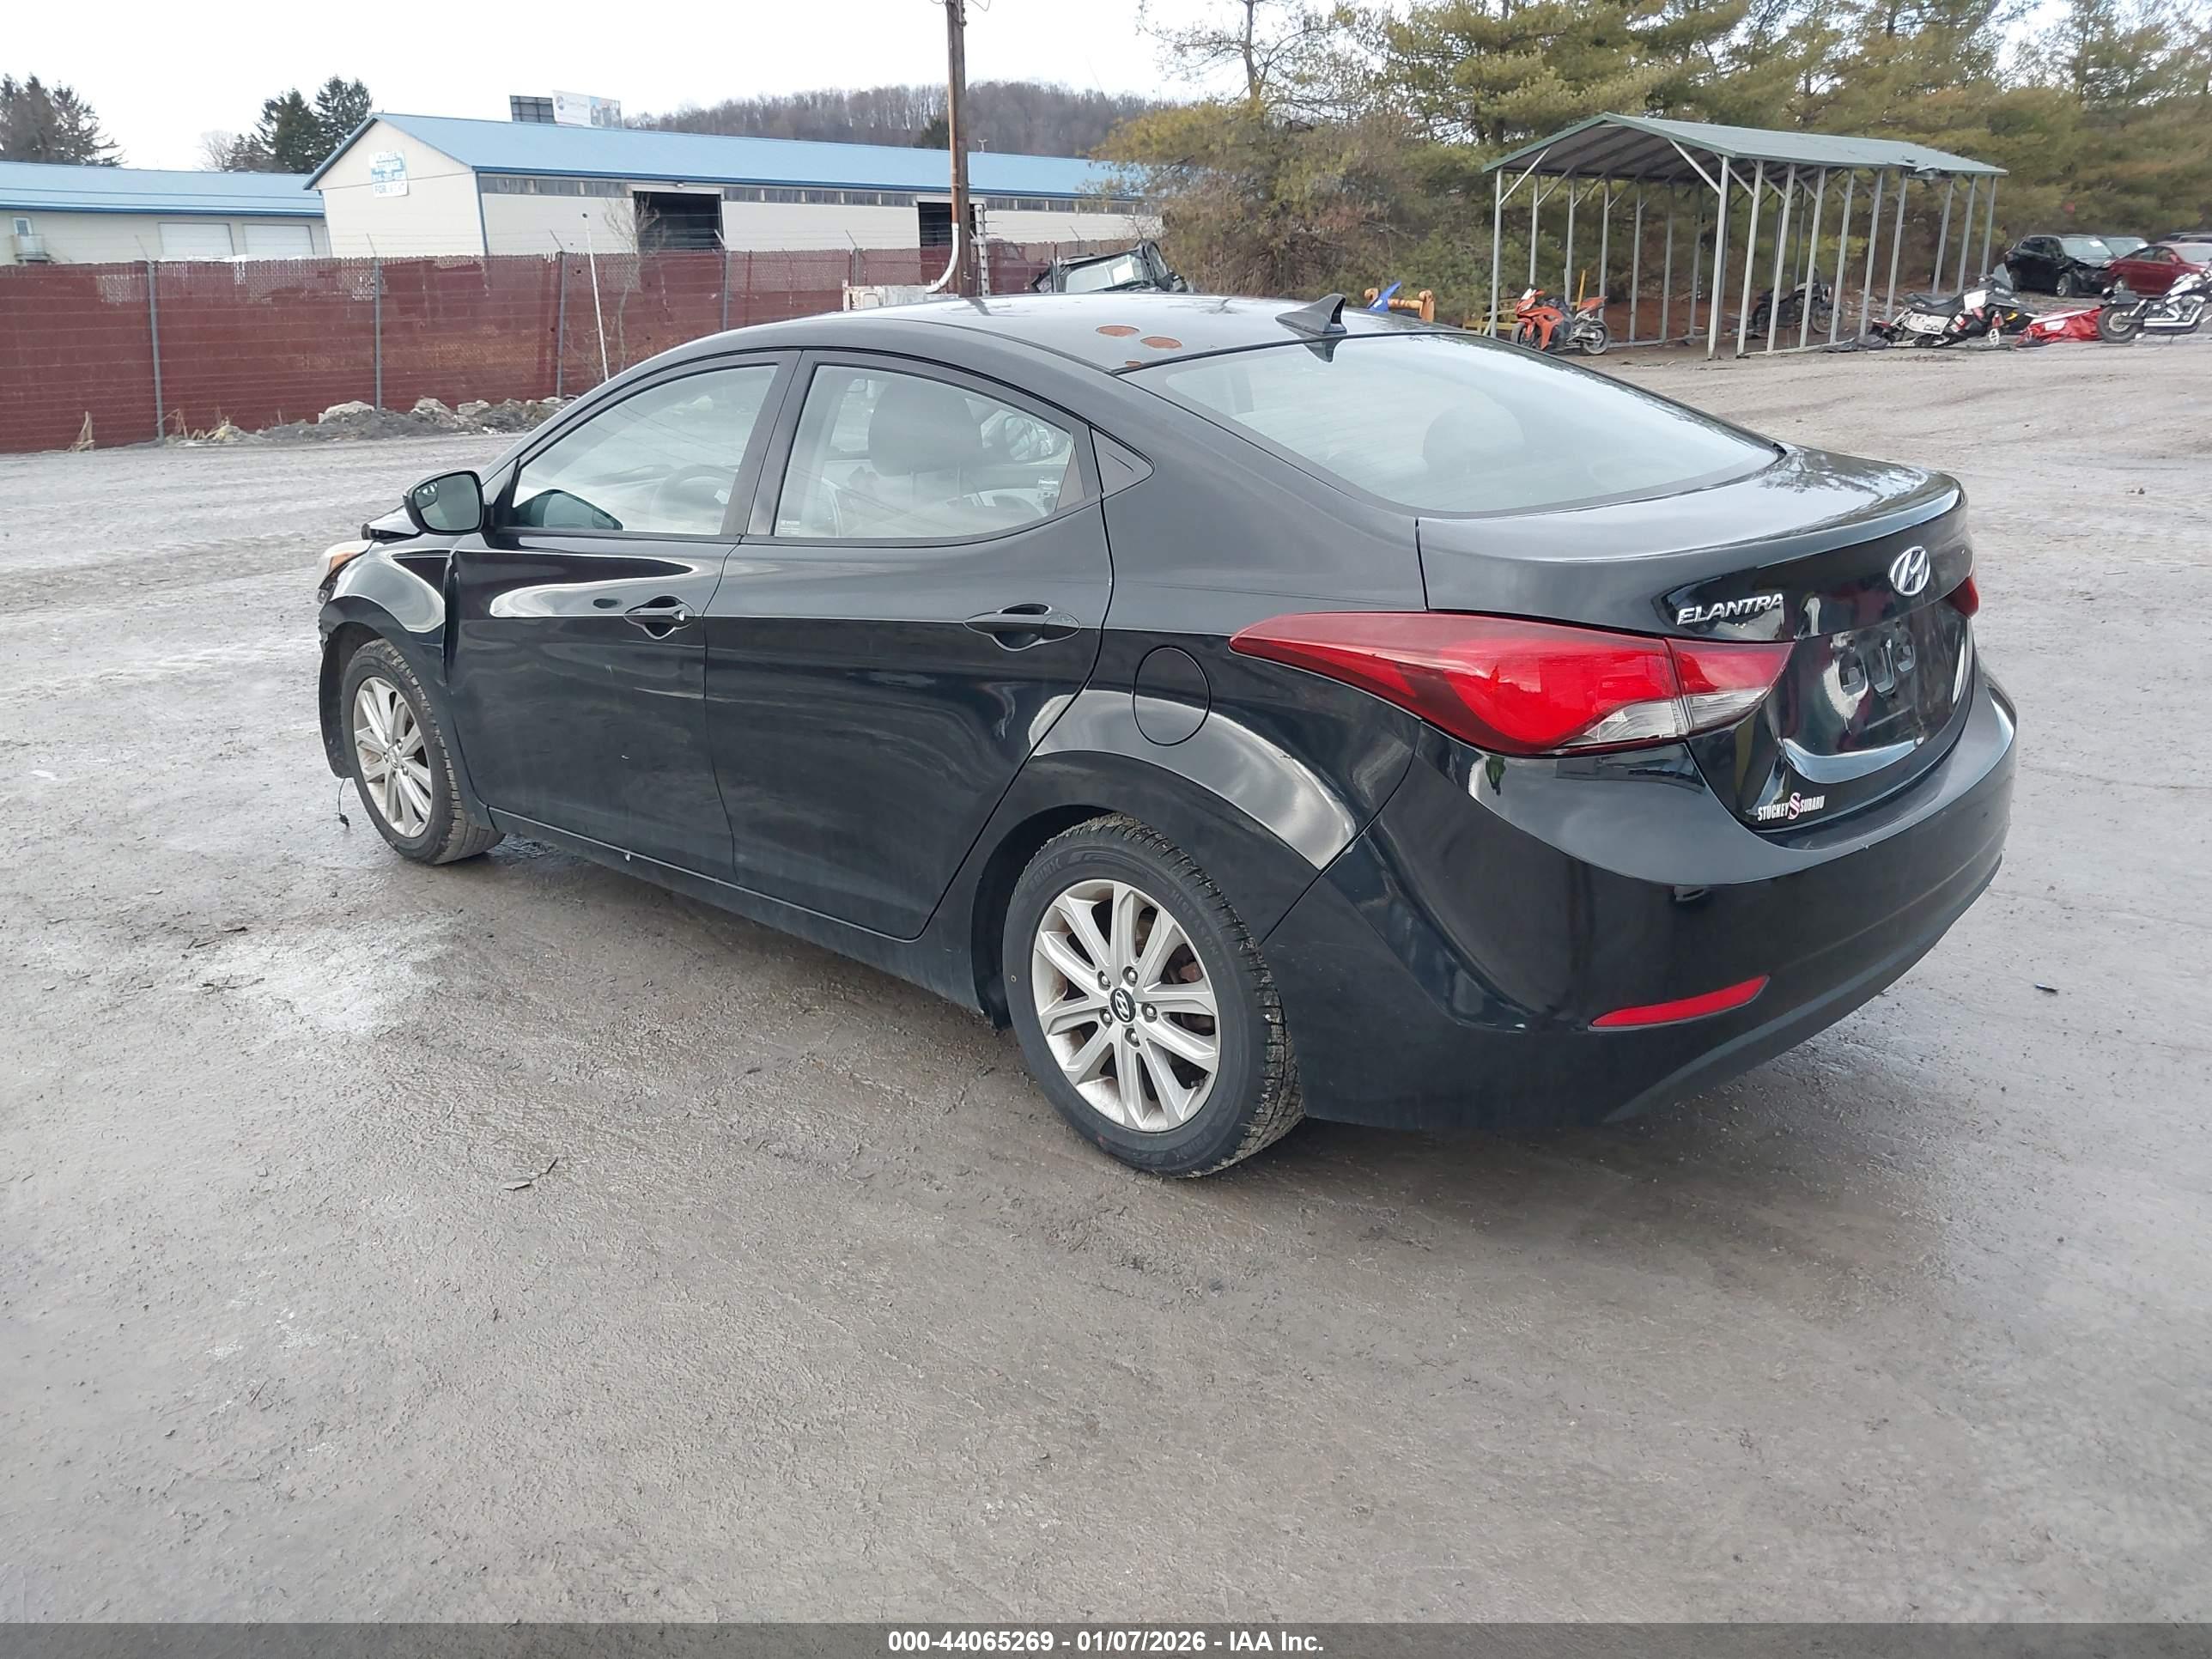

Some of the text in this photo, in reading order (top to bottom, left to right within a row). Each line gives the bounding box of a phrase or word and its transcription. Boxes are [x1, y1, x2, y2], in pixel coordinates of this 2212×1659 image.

[1676, 592, 1785, 626] ELANTRA
[1757, 802, 1789, 822] STUCKEY
[1800, 795, 1826, 813] SUBARU
